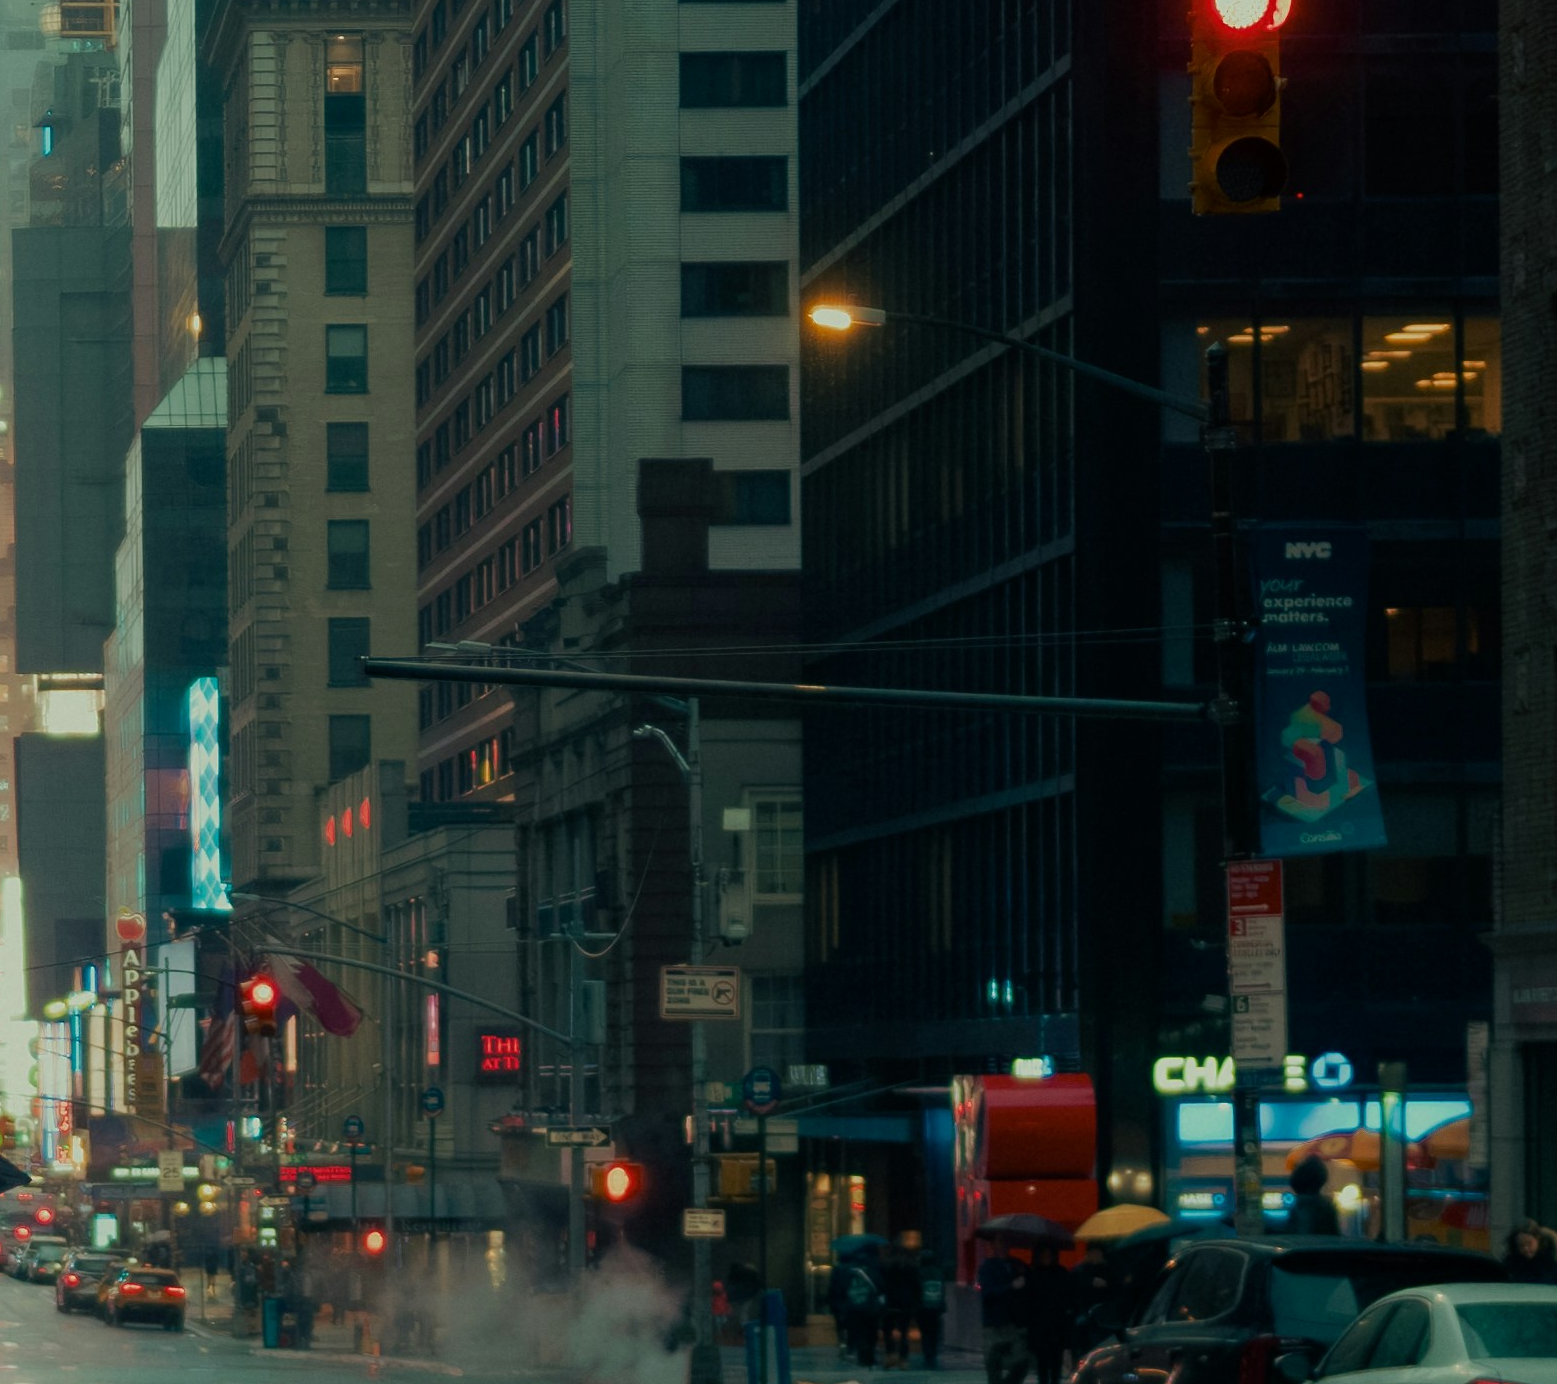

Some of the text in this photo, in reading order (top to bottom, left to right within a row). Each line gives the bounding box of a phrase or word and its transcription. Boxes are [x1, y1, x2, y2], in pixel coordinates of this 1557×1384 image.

[1285, 541, 1332, 560] NYC
[1260, 578, 1304, 602] your
[1263, 593, 1353, 611] experience
[1263, 611, 1330, 624] matters.
[1153, 1054, 1307, 1093] CHAE
